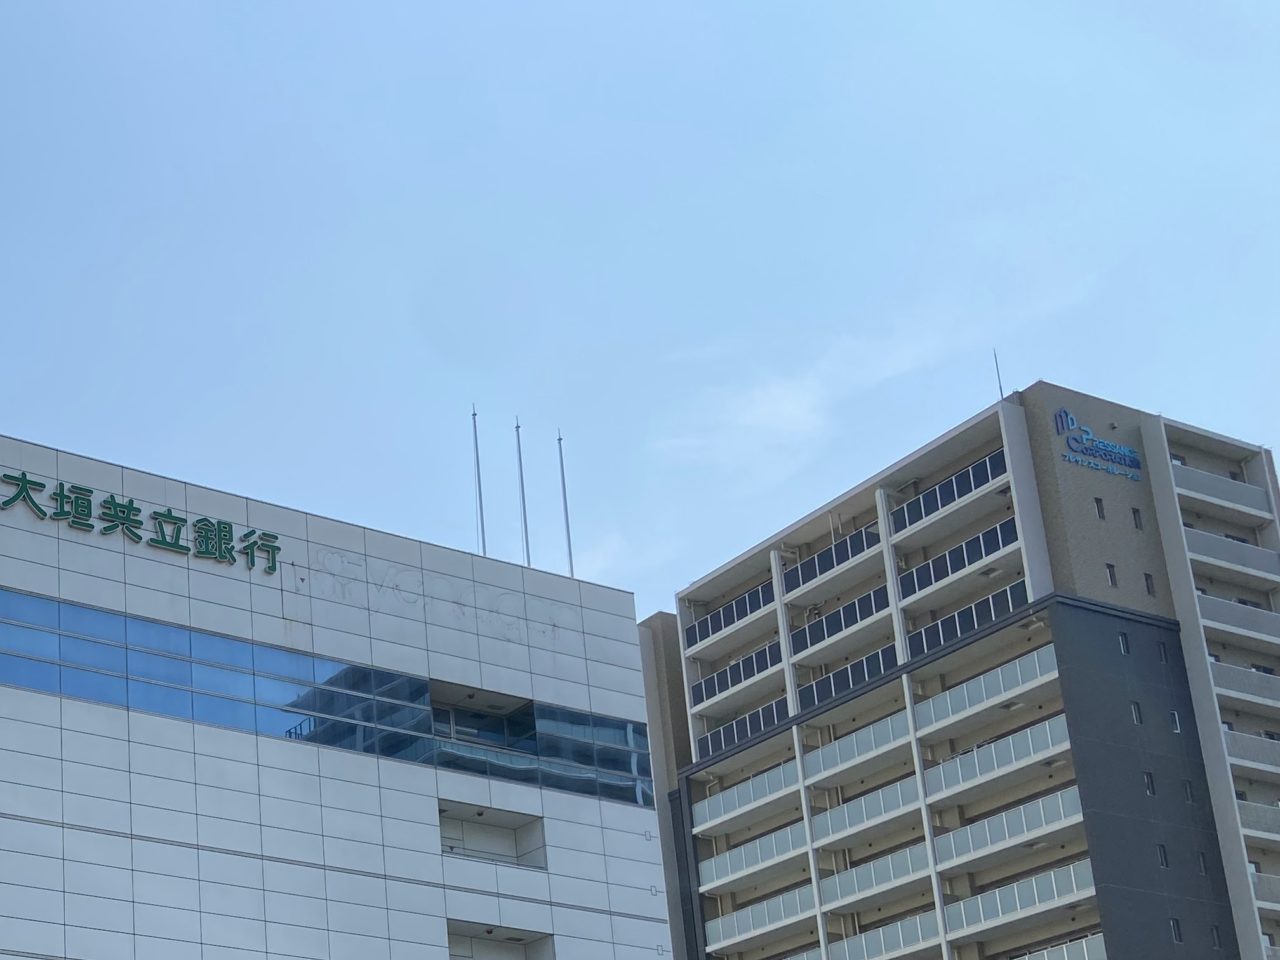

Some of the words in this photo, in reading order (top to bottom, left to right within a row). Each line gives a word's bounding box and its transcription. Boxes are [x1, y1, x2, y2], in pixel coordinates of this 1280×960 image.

[0, 471, 282, 575] 大垣共立銀行
